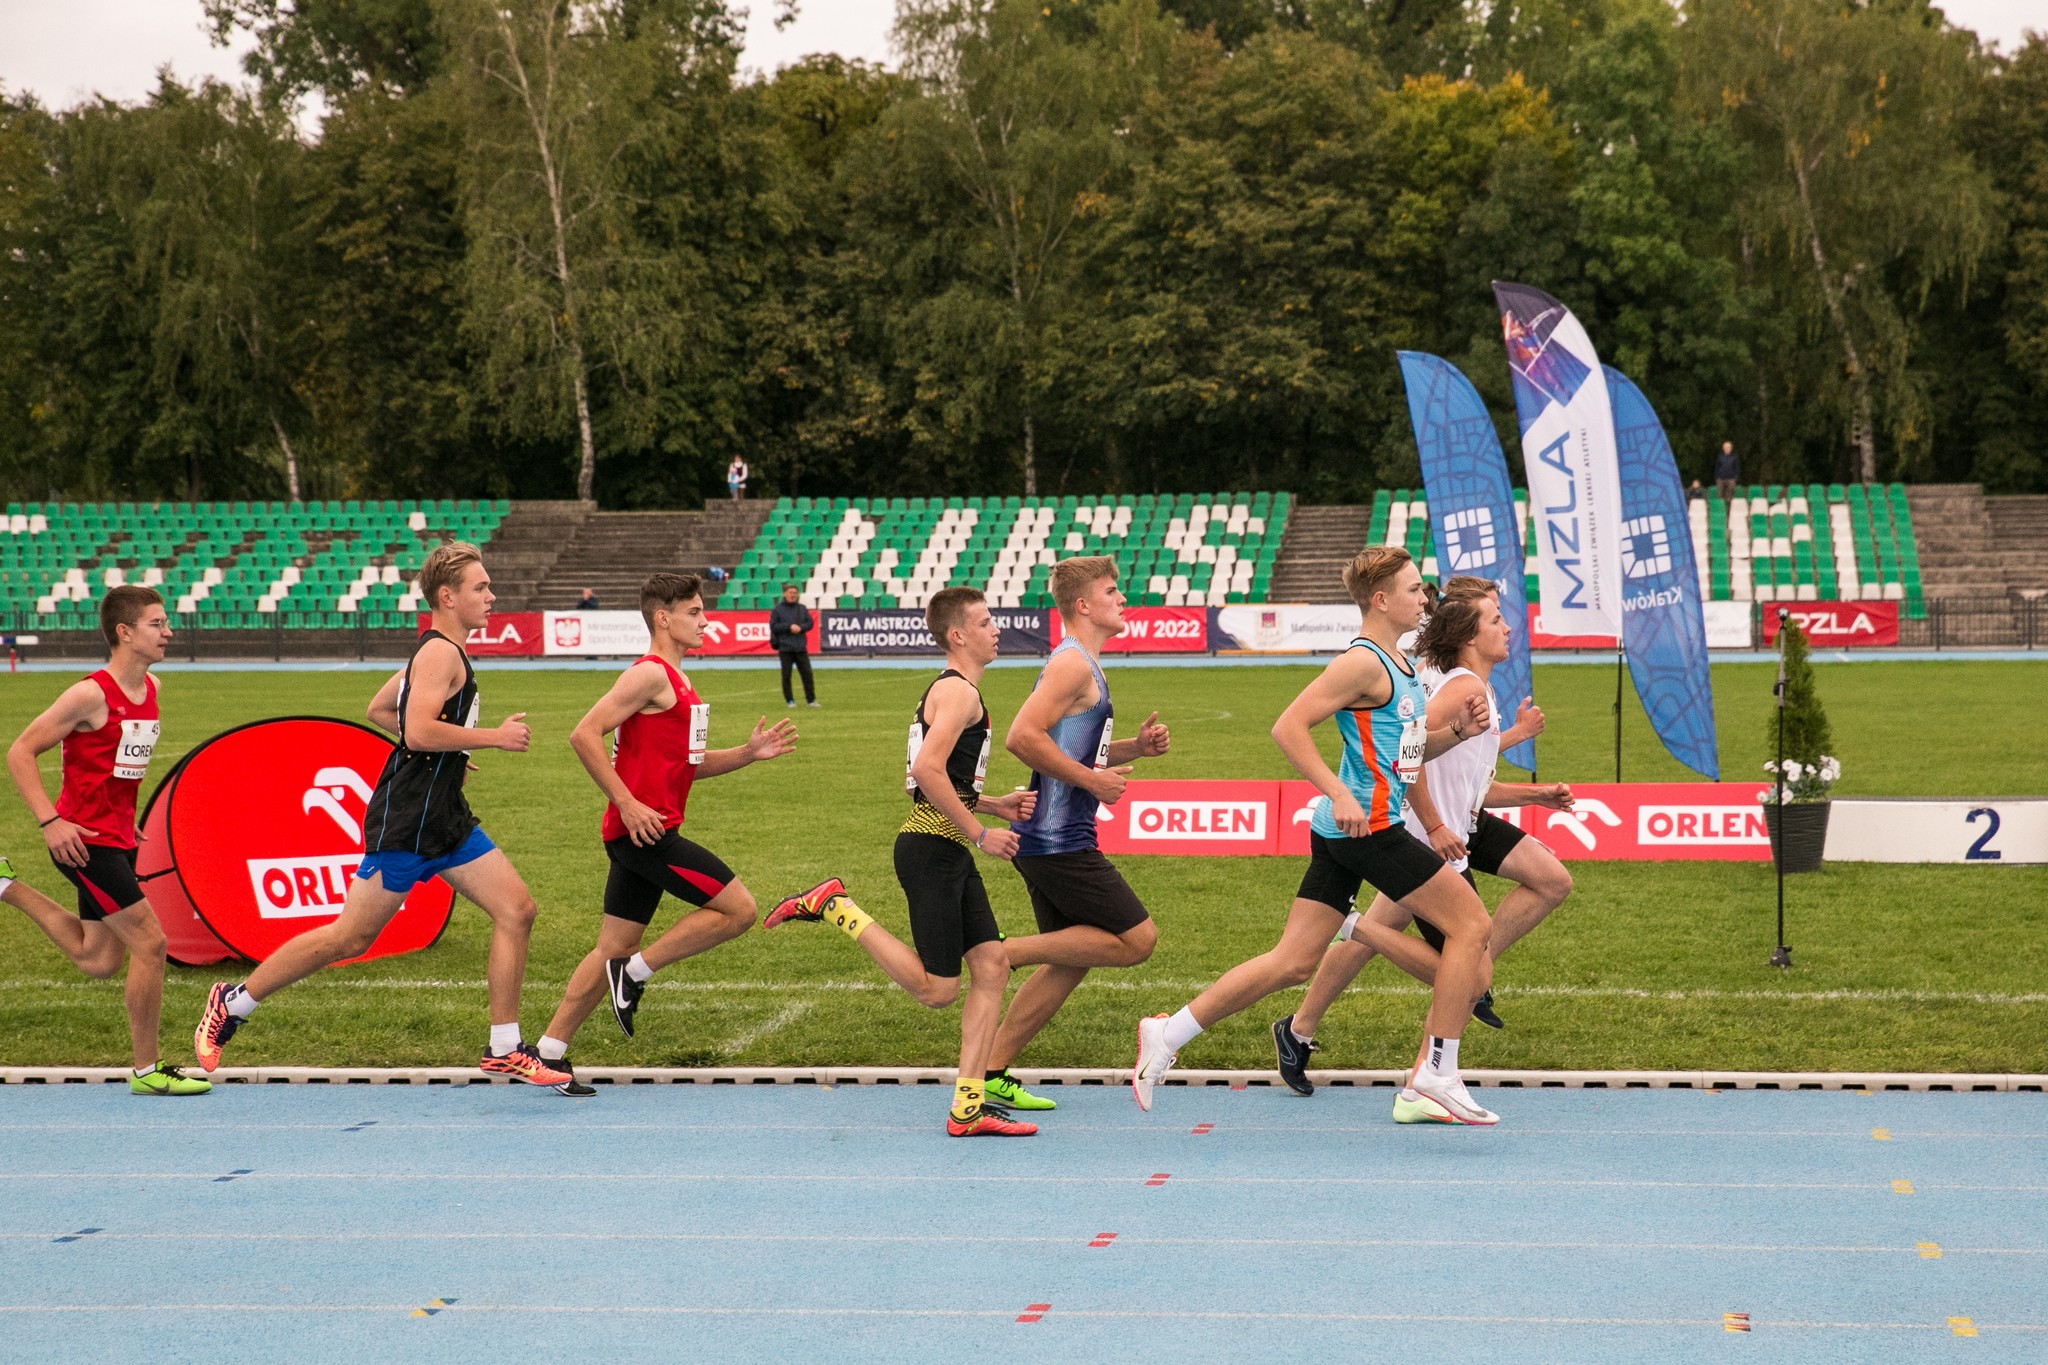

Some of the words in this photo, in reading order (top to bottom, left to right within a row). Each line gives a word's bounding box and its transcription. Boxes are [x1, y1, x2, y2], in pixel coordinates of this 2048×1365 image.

[1580, 428, 1591, 467] ATLETYKI
[1539, 430, 1588, 610] MZLA
[465, 623, 523, 644] ZLA
[740, 626, 769, 637] ORL
[828, 617, 860, 631] PZLA
[863, 616, 929, 631] MISTRZOS
[1013, 615, 1041, 630] U16
[1153, 619, 1201, 638] 2022
[828, 633, 842, 647] W
[844, 632, 937, 647] WIELOBOJAC
[1138, 807, 1257, 833] ORLEN
[1647, 812, 1770, 838] ORLEN
[1964, 807, 2002, 860] 2
[1431, 1049, 1443, 1070] NIKE
